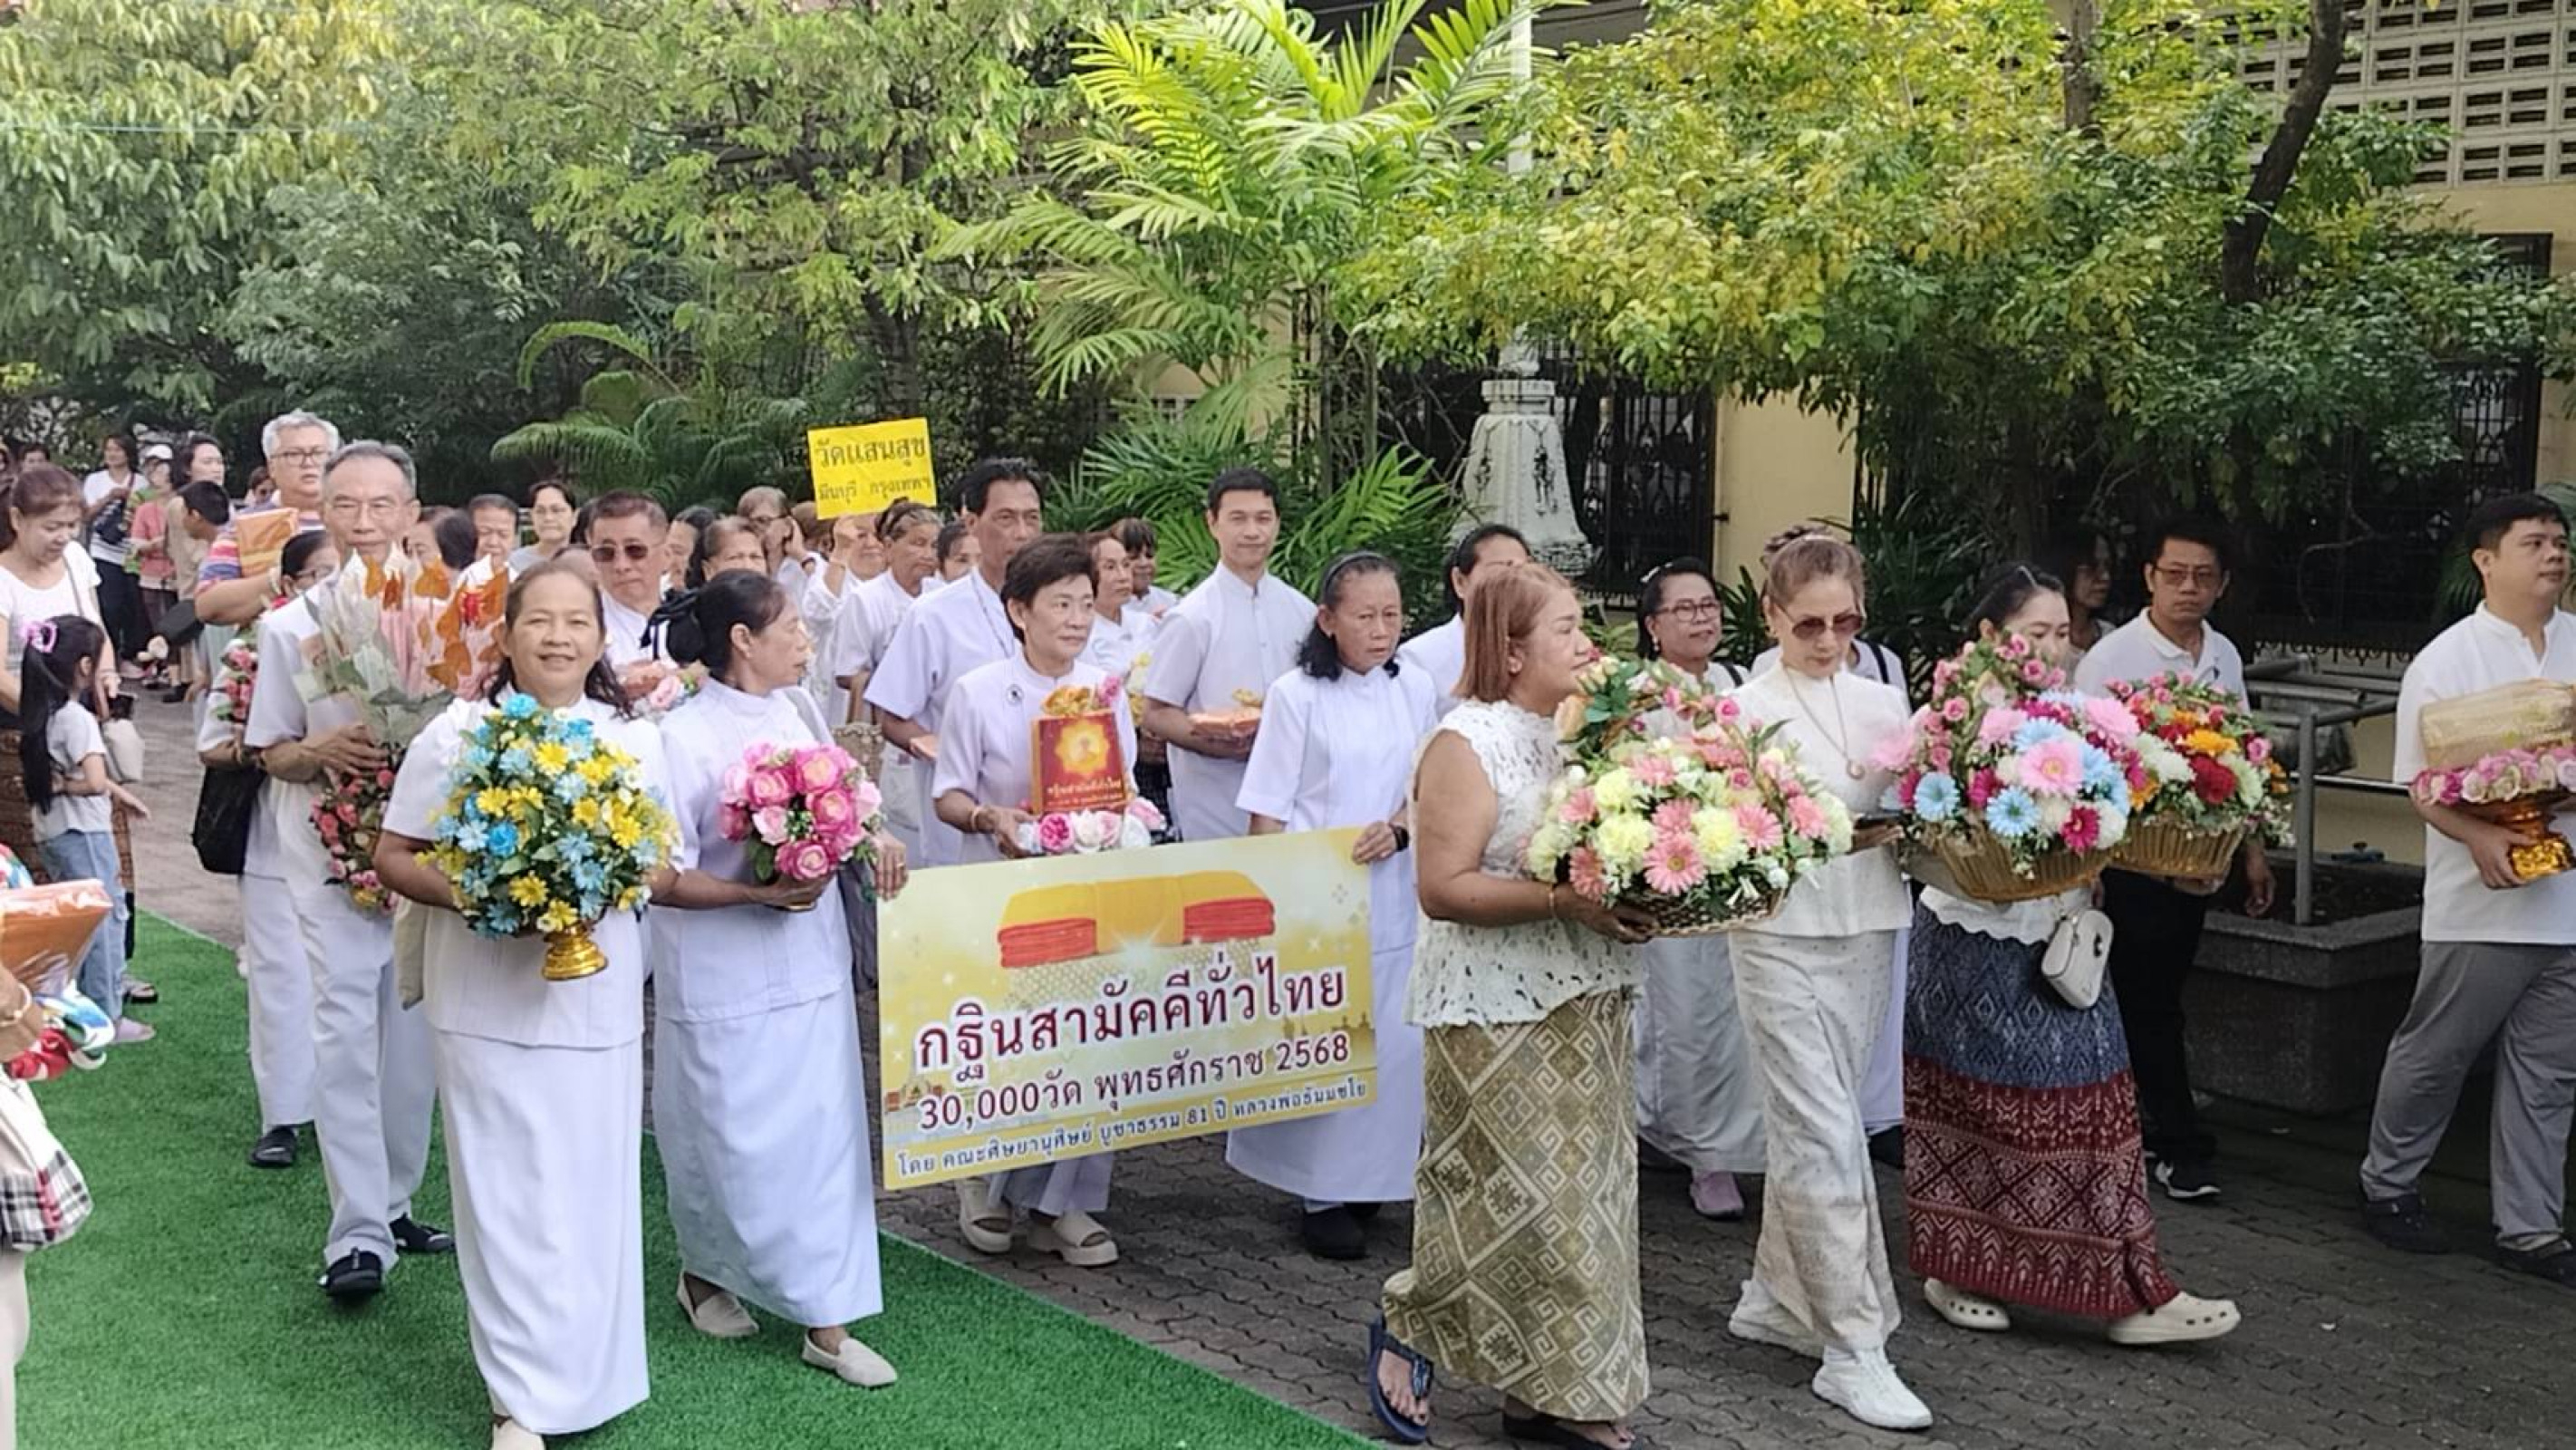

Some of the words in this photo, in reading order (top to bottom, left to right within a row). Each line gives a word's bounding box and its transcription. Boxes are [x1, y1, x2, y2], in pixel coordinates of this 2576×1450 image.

[815, 437, 925, 467] วัดแสนสุข
[919, 952, 1344, 1081] กฐินสามัคคีทั่วไทย
[921, 1068, 1081, 1130] 30,000วัด
[1095, 1049, 1264, 1111] พุทธศักราช
[1277, 1035, 1349, 1071] 2568
[898, 1154, 935, 1175] โดย
[943, 1123, 1093, 1166] คณะศิษยานุศิษย์
[1100, 1114, 1180, 1146] บูชาธรรม
[1186, 1108, 1208, 1125] 81
[1215, 1100, 1228, 1120] ปี
